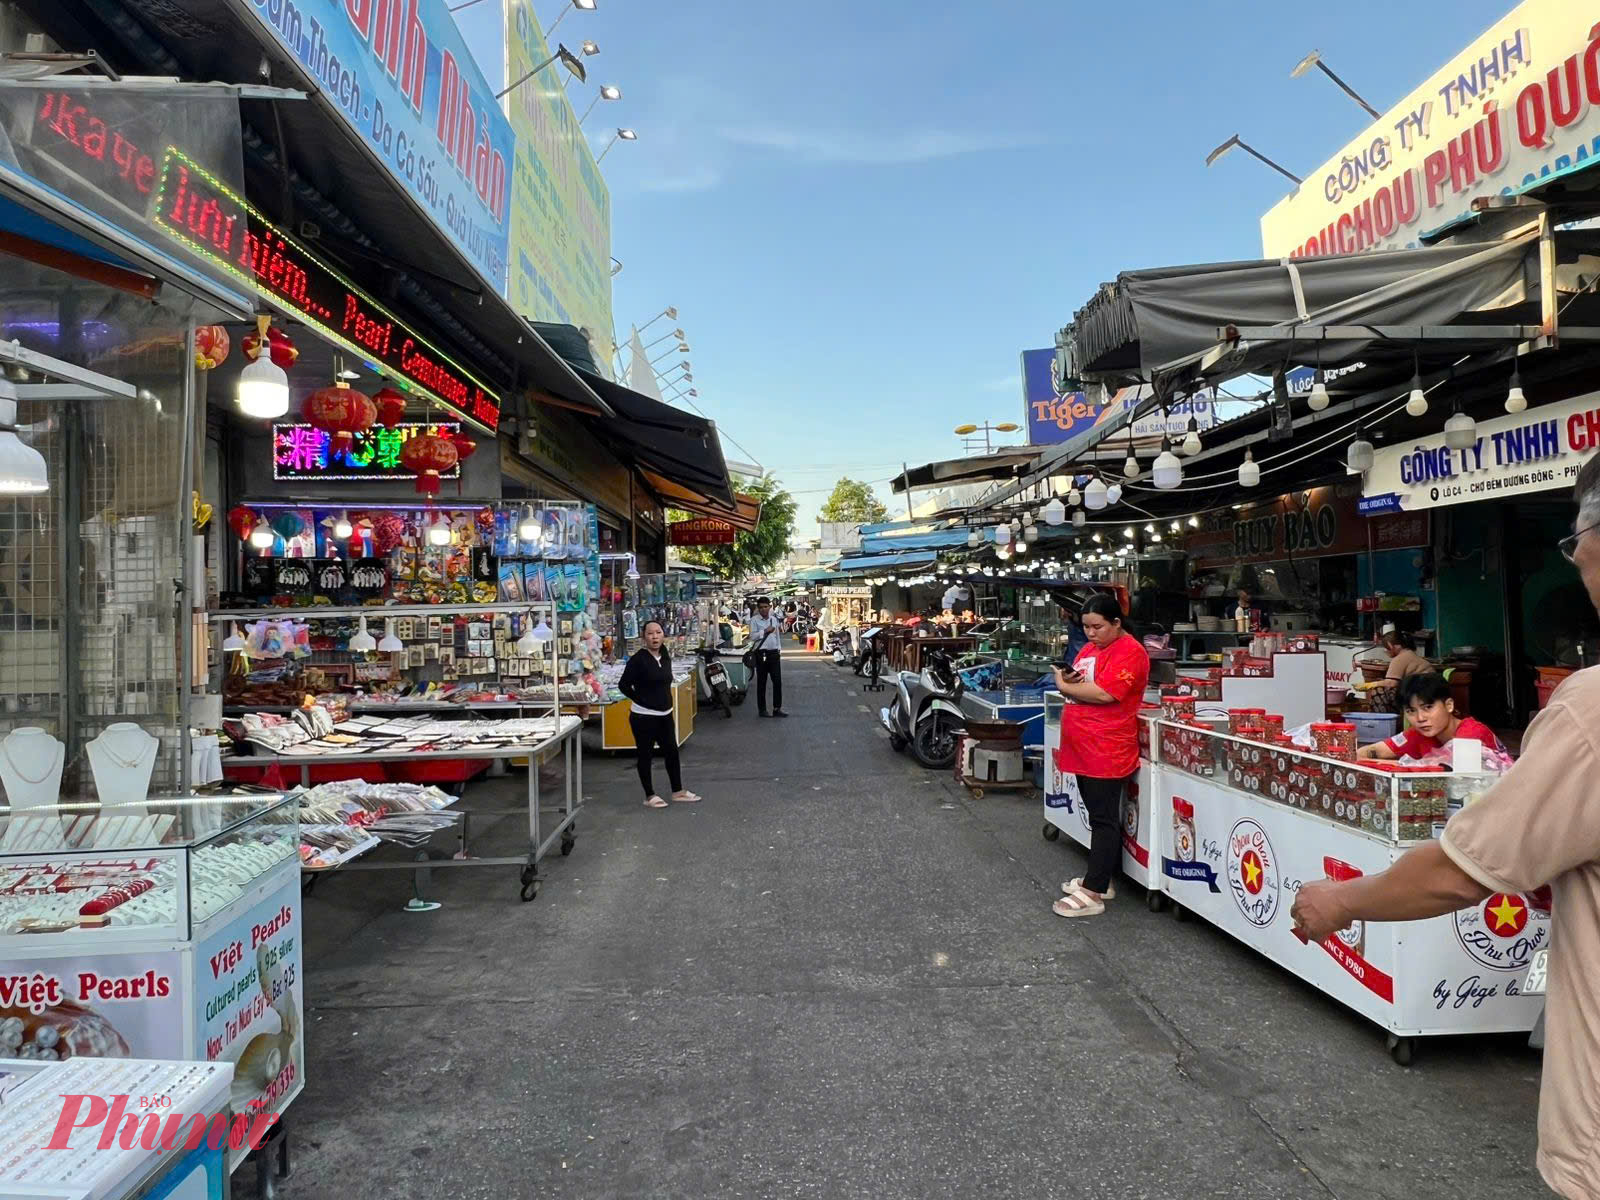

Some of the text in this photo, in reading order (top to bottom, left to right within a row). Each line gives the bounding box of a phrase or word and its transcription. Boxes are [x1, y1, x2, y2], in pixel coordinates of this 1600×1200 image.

[1324, 28, 1532, 203] CÔNG TY TNHH
[1424, 98, 1507, 210] PHÚ
[342, 293, 392, 356] Pearl
[1032, 395, 1096, 430] Tiger
[1400, 446, 1457, 485] CÔNG
[1491, 419, 1562, 466] TNHH
[674, 520, 731, 531] KINGKONG
[1233, 514, 1279, 558] HUY
[1171, 866, 1207, 878] THE ORIGINAL
[209, 904, 292, 980] Việt Pearls
[1462, 927, 1546, 968] Phu Quoc
[205, 979, 236, 1023] Cultured
[236, 966, 257, 1002] pearls
[264, 946, 278, 971] 925
[279, 937, 294, 961] silver
[1345, 955, 1365, 979] 1980
[0, 969, 170, 1012] Việt Pearls
[225, 1013, 237, 1046] Trai
[284, 962, 295, 991] 925
[1433, 975, 1520, 1010] by Gégé la
[279, 1057, 295, 1097] 336
